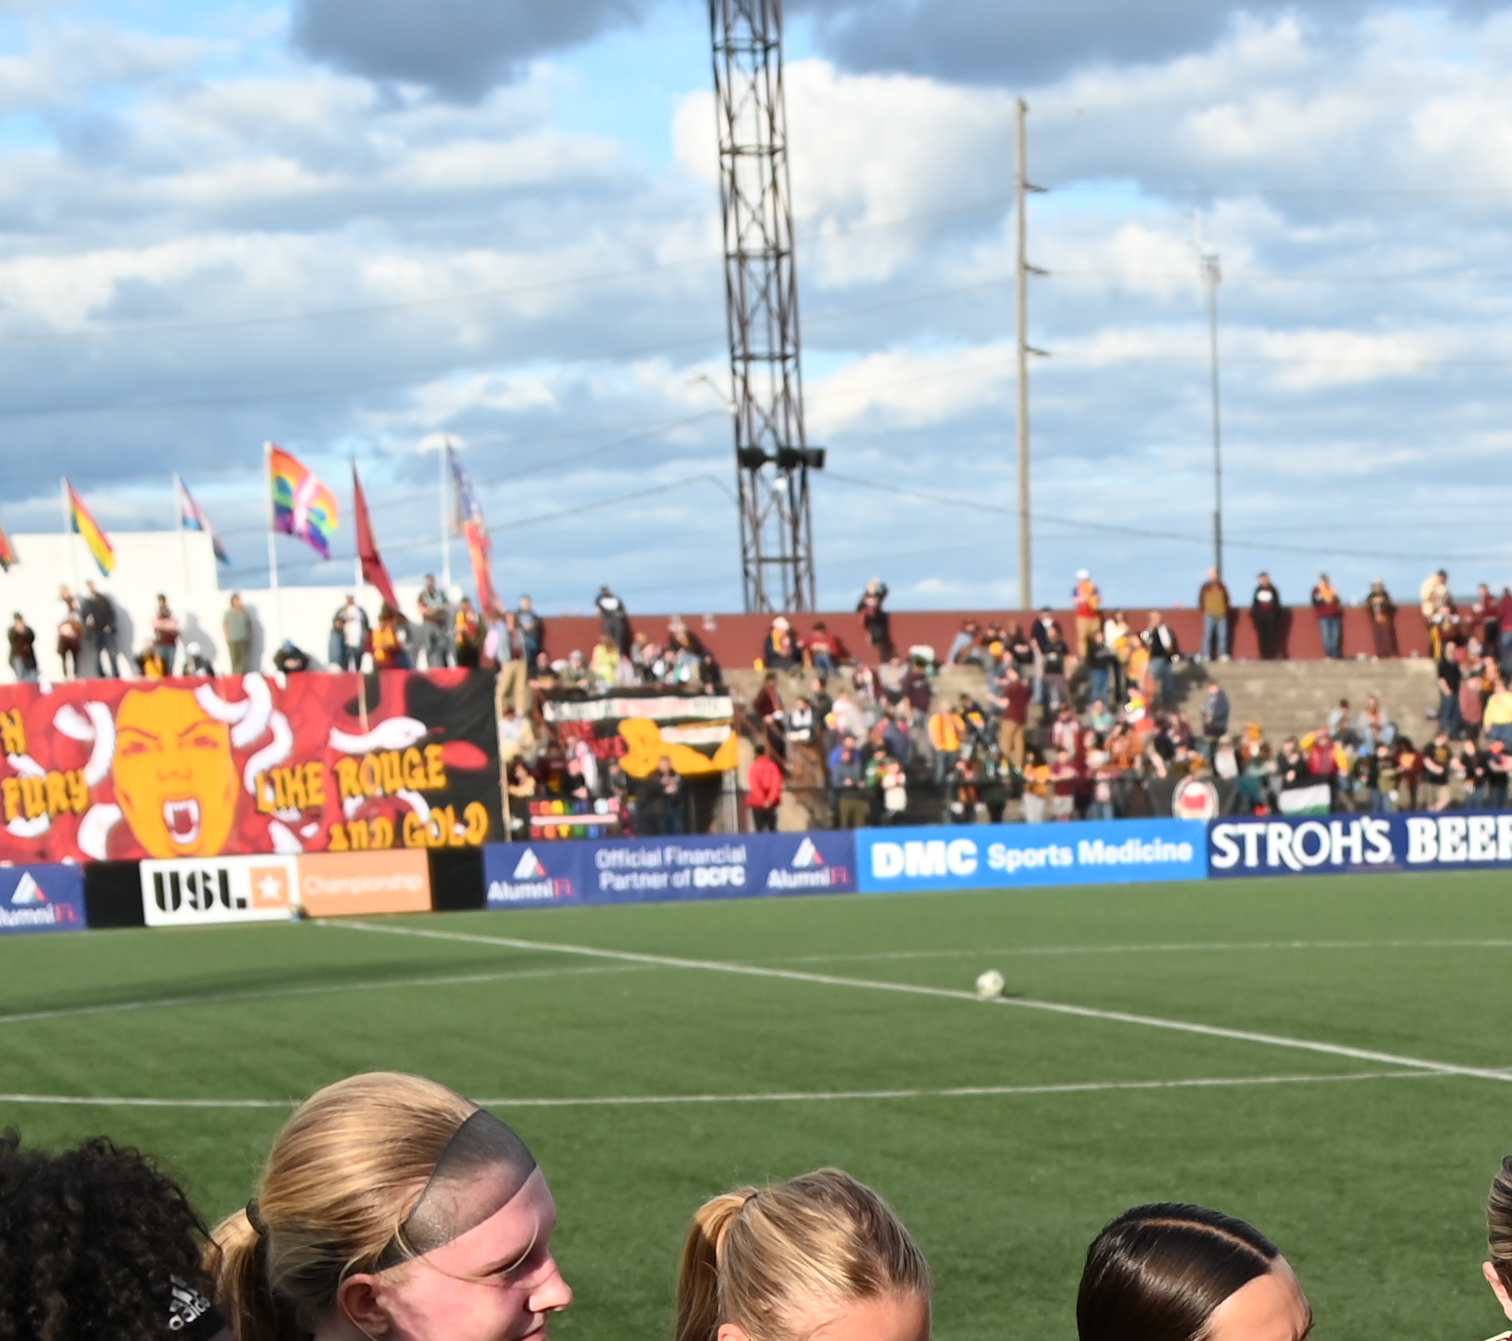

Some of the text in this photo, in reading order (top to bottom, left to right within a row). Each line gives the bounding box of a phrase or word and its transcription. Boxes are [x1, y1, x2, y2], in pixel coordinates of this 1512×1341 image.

[1, 769, 90, 821] FURY
[255, 743, 446, 815] LIKE ROUGE
[403, 801, 489, 848] GOLD
[1210, 816, 1391, 872] STROH'S
[595, 844, 746, 870] Official Financial
[598, 865, 746, 890] Partner of DCFC
[871, 837, 1194, 879] DMC Sports Medicine
[153, 869, 247, 912] USL
[303, 872, 424, 895] Championship
